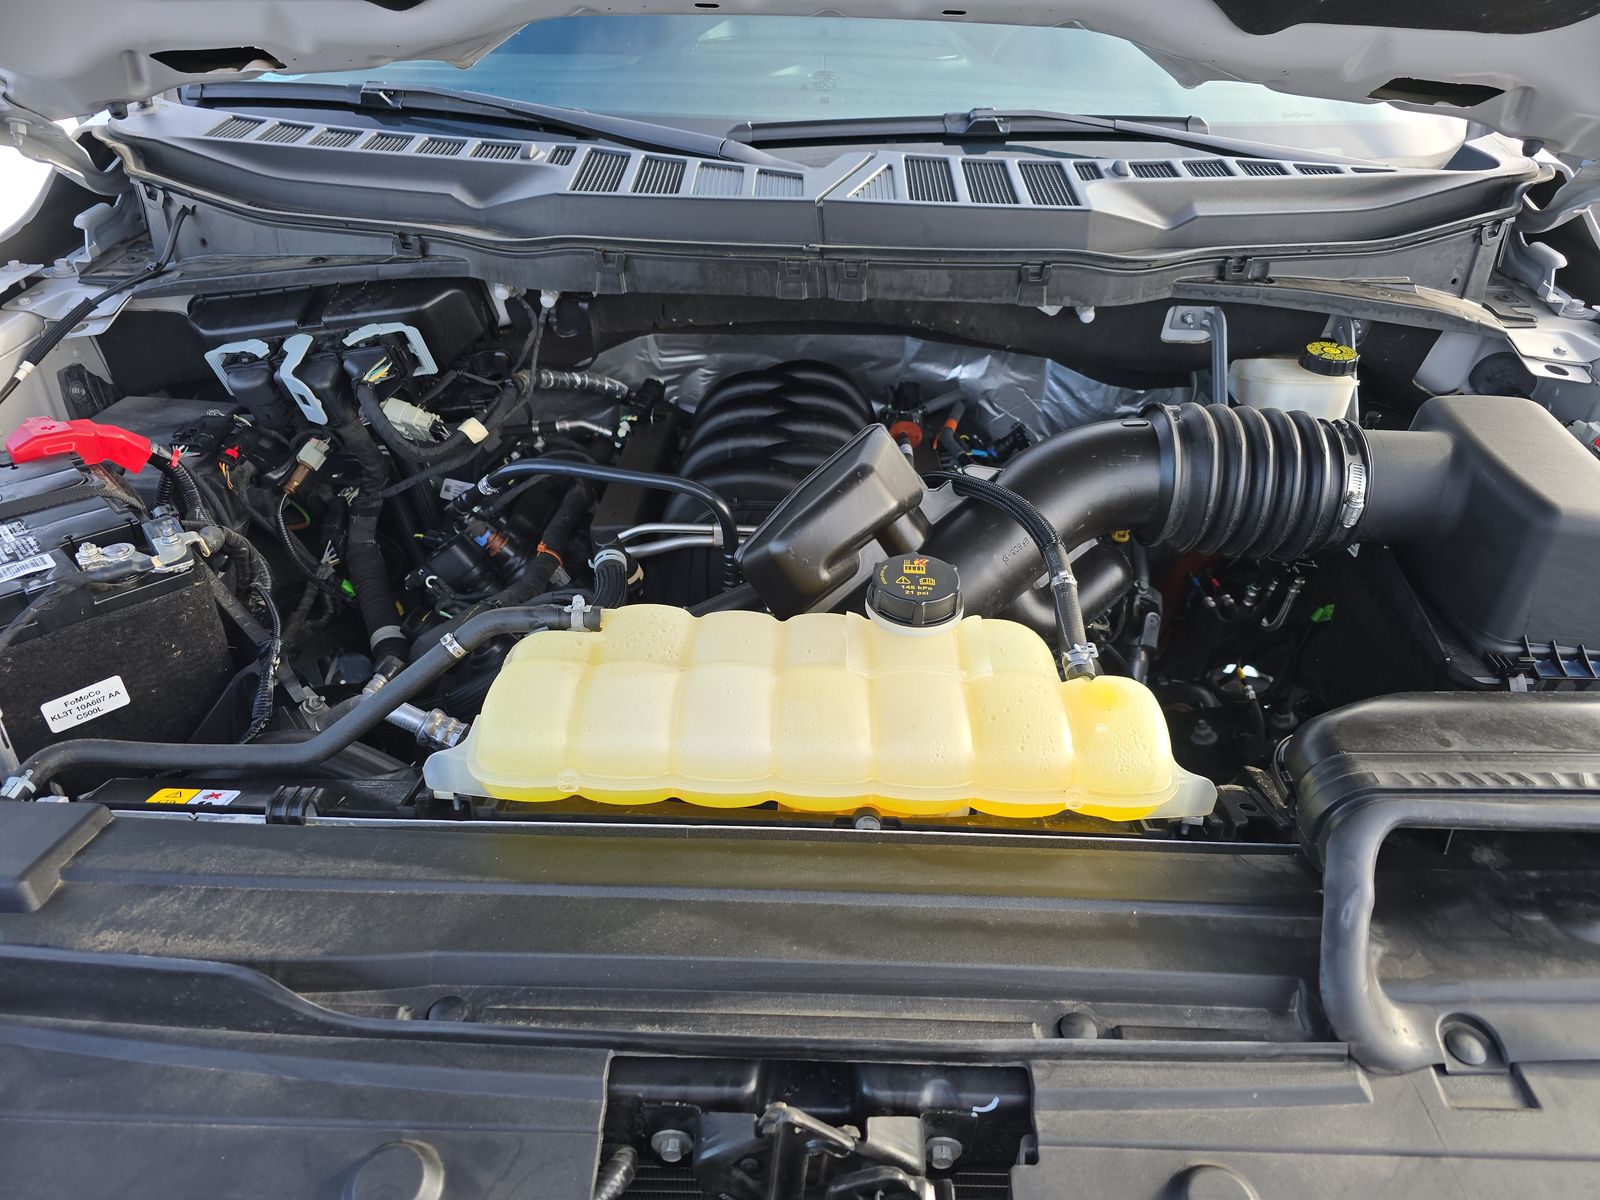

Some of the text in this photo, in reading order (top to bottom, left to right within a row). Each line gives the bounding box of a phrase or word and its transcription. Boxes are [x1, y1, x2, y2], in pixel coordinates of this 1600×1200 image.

[50, 690, 121, 722] KL3T 10A687 AA
[64, 689, 101, 708] FoMoCo
[76, 706, 103, 720] C500L
